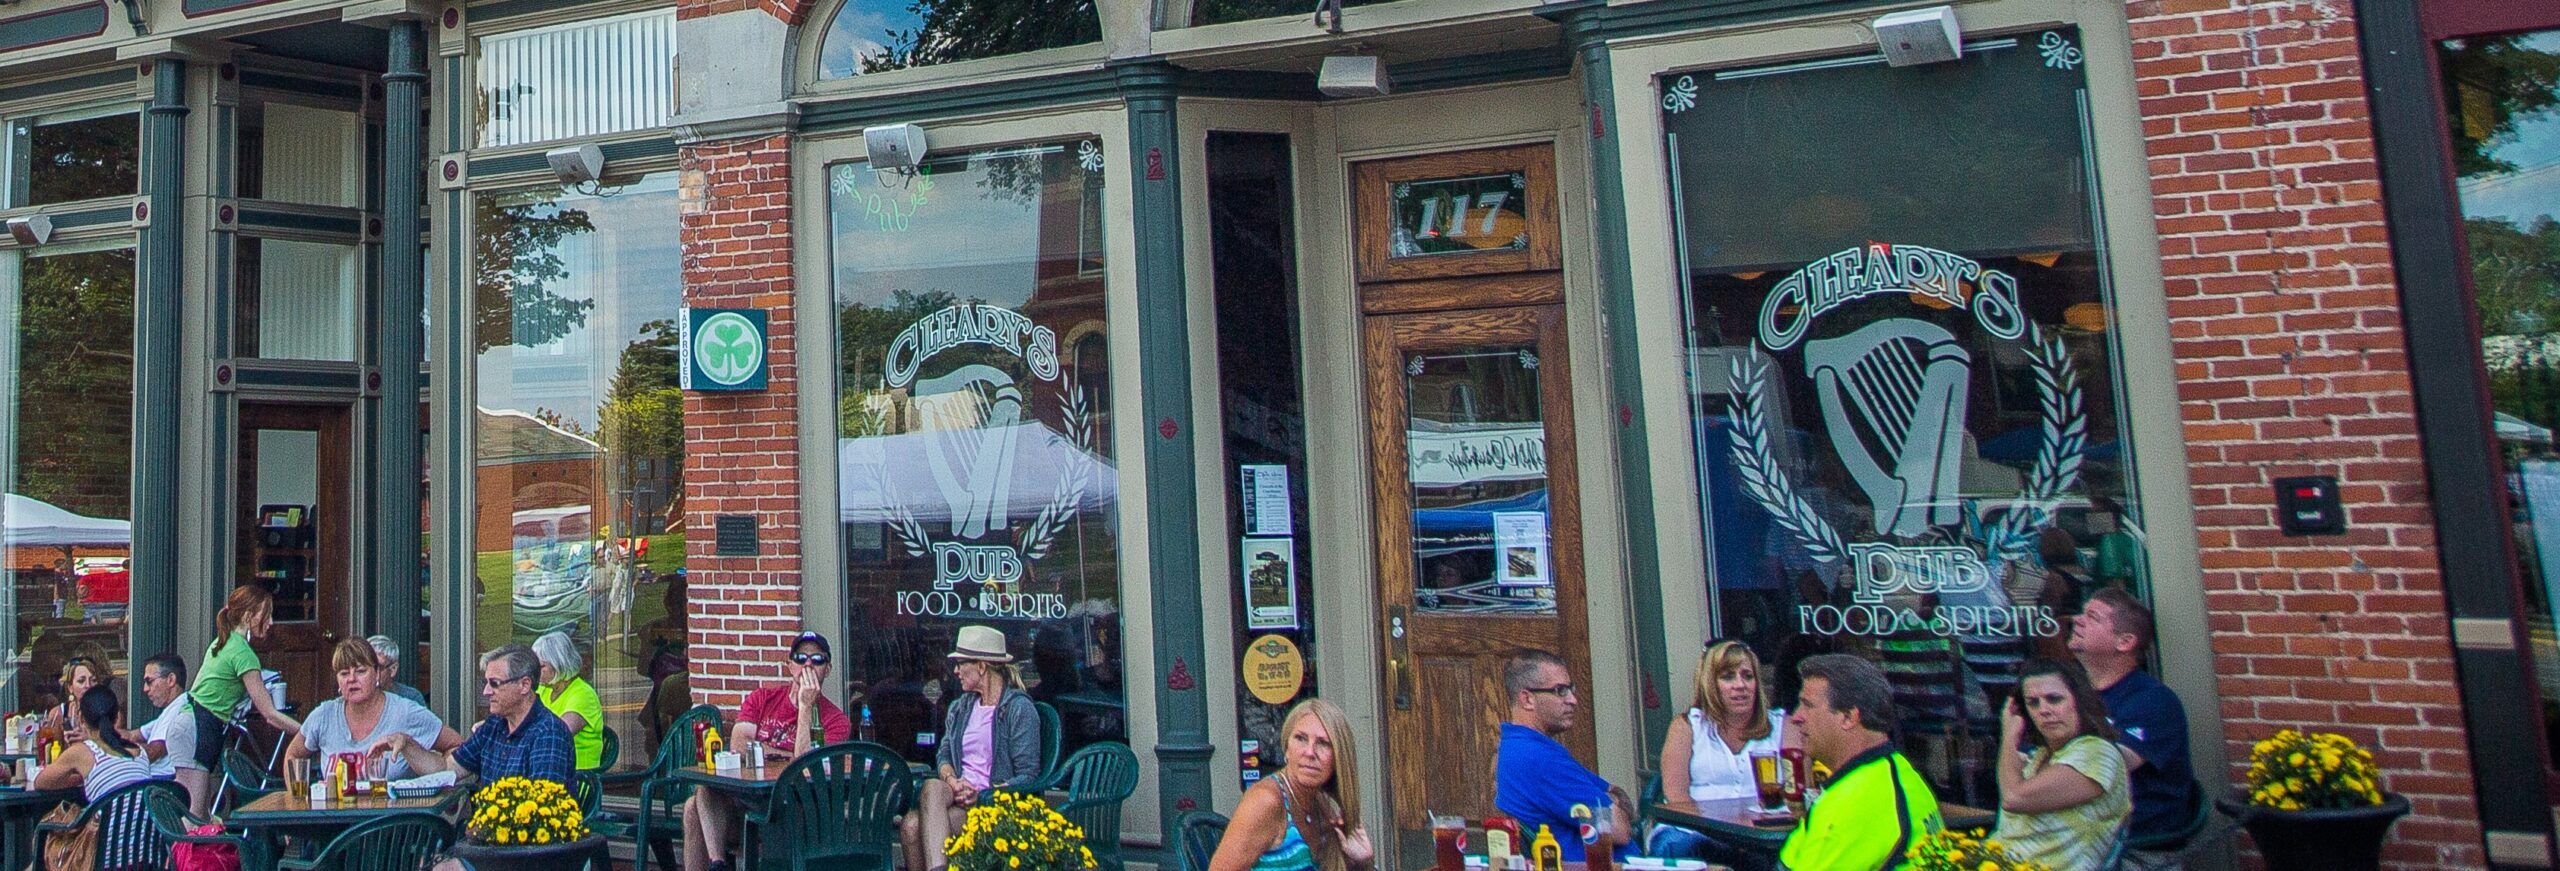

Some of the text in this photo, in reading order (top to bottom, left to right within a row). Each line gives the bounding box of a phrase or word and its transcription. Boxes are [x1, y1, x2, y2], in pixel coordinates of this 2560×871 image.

[864, 193, 909, 232] Pub
[1415, 191, 1509, 240] 117
[1759, 245, 2025, 350] CLEARY'S
[681, 314, 689, 386] APPROVED
[886, 304, 1059, 388] CLEARY'S
[933, 542, 1023, 590] PUB
[1849, 542, 1989, 603] PUB
[897, 591, 1067, 619] FOOD SPIRITS
[1799, 605, 2060, 637] FOOD SPIRITS
